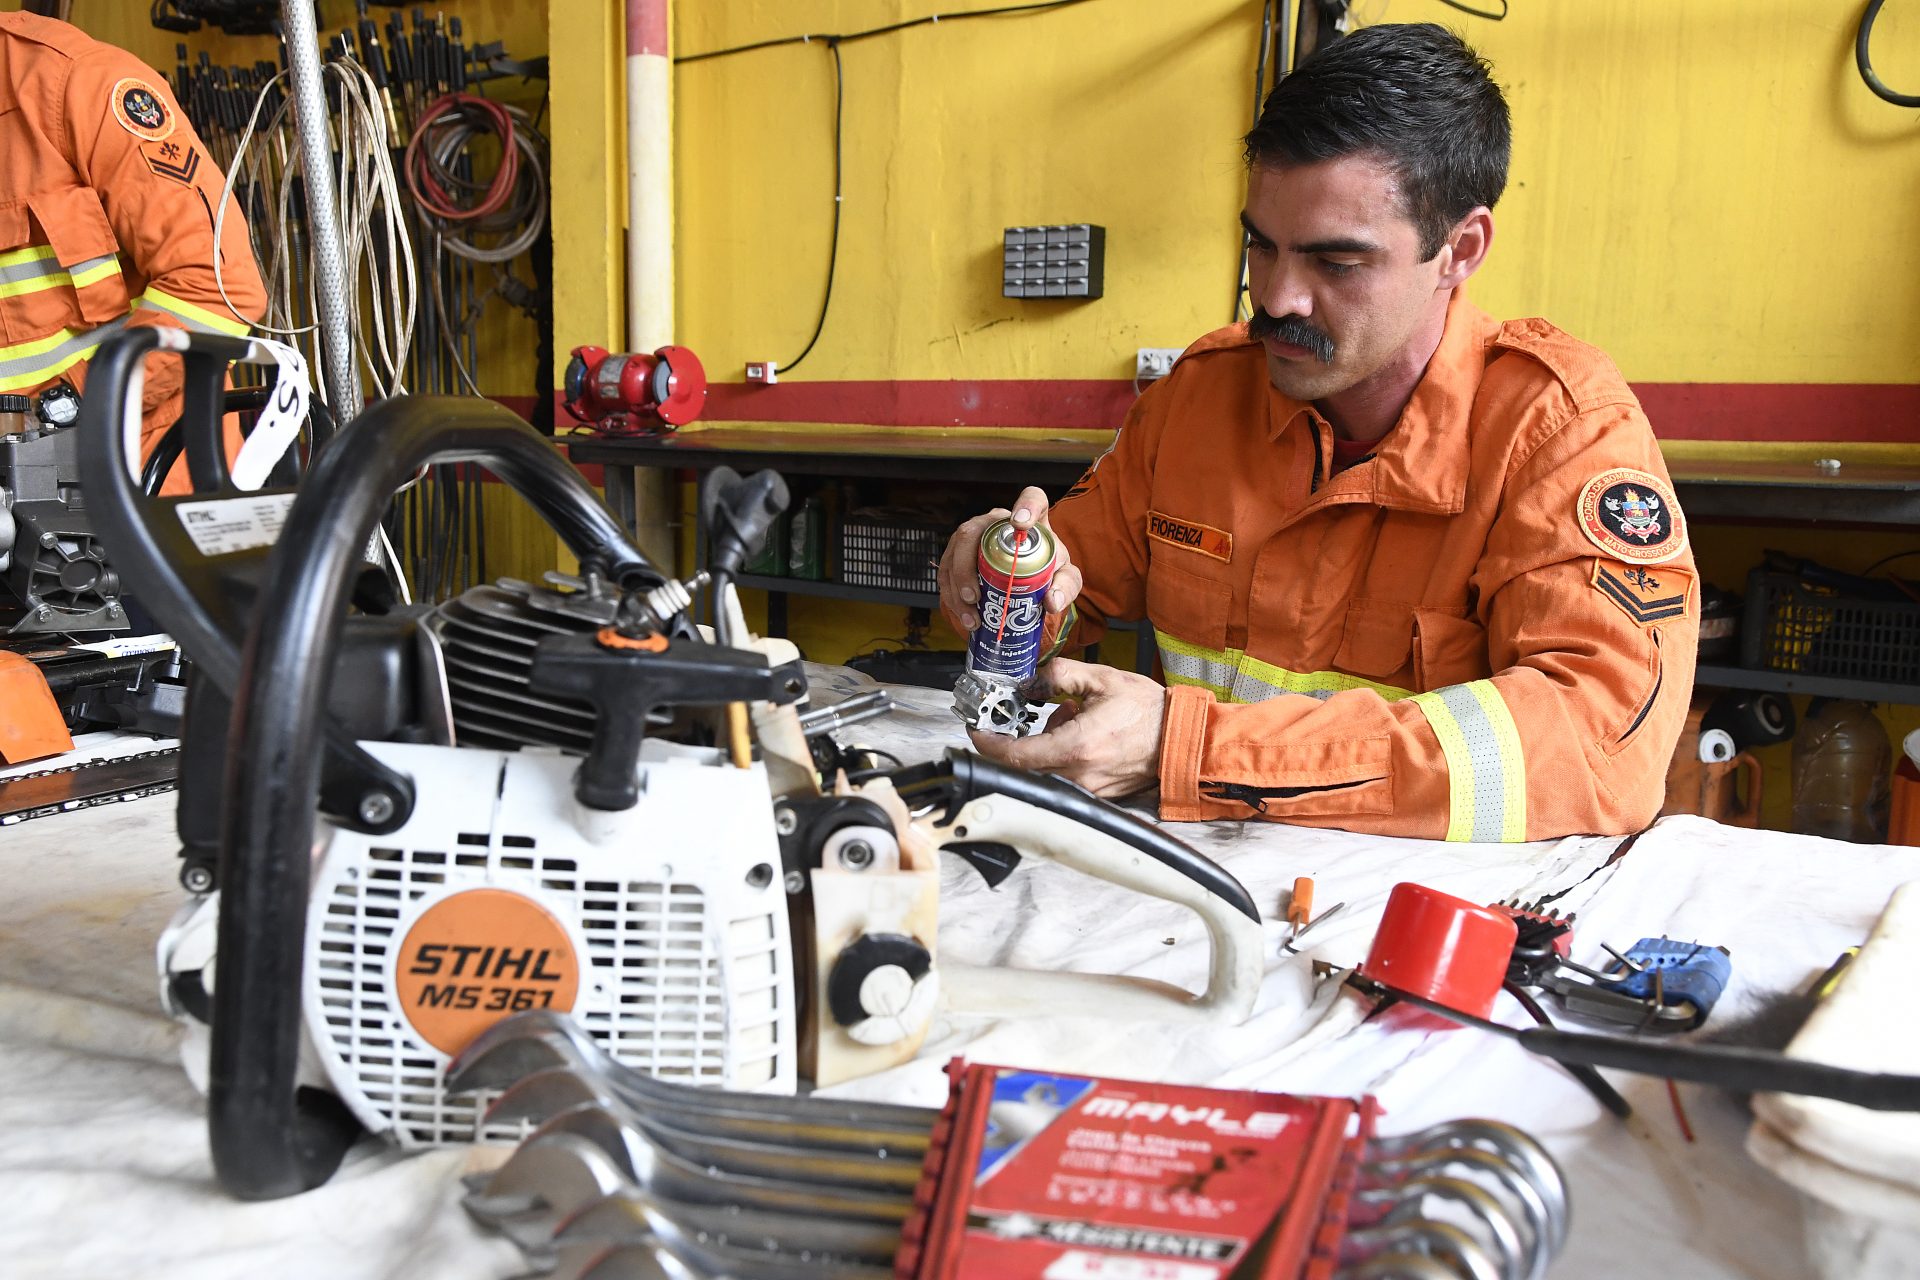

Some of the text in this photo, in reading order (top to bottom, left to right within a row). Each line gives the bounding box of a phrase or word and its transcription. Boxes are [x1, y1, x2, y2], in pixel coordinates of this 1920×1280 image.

[1584, 490, 1596, 521] CORPO
[1593, 480, 1604, 492] DE
[1604, 472, 1656, 486] BOMBEIROS
[1151, 517, 1203, 546] FIORENZA
[1603, 536, 1628, 554] MATO
[1628, 547, 1663, 557] GROSSO
[1662, 543, 1675, 553] DO
[410, 943, 562, 981] STIHL
[417, 984, 553, 1012] MS 361
[1081, 1097, 1291, 1133] MAYLE
